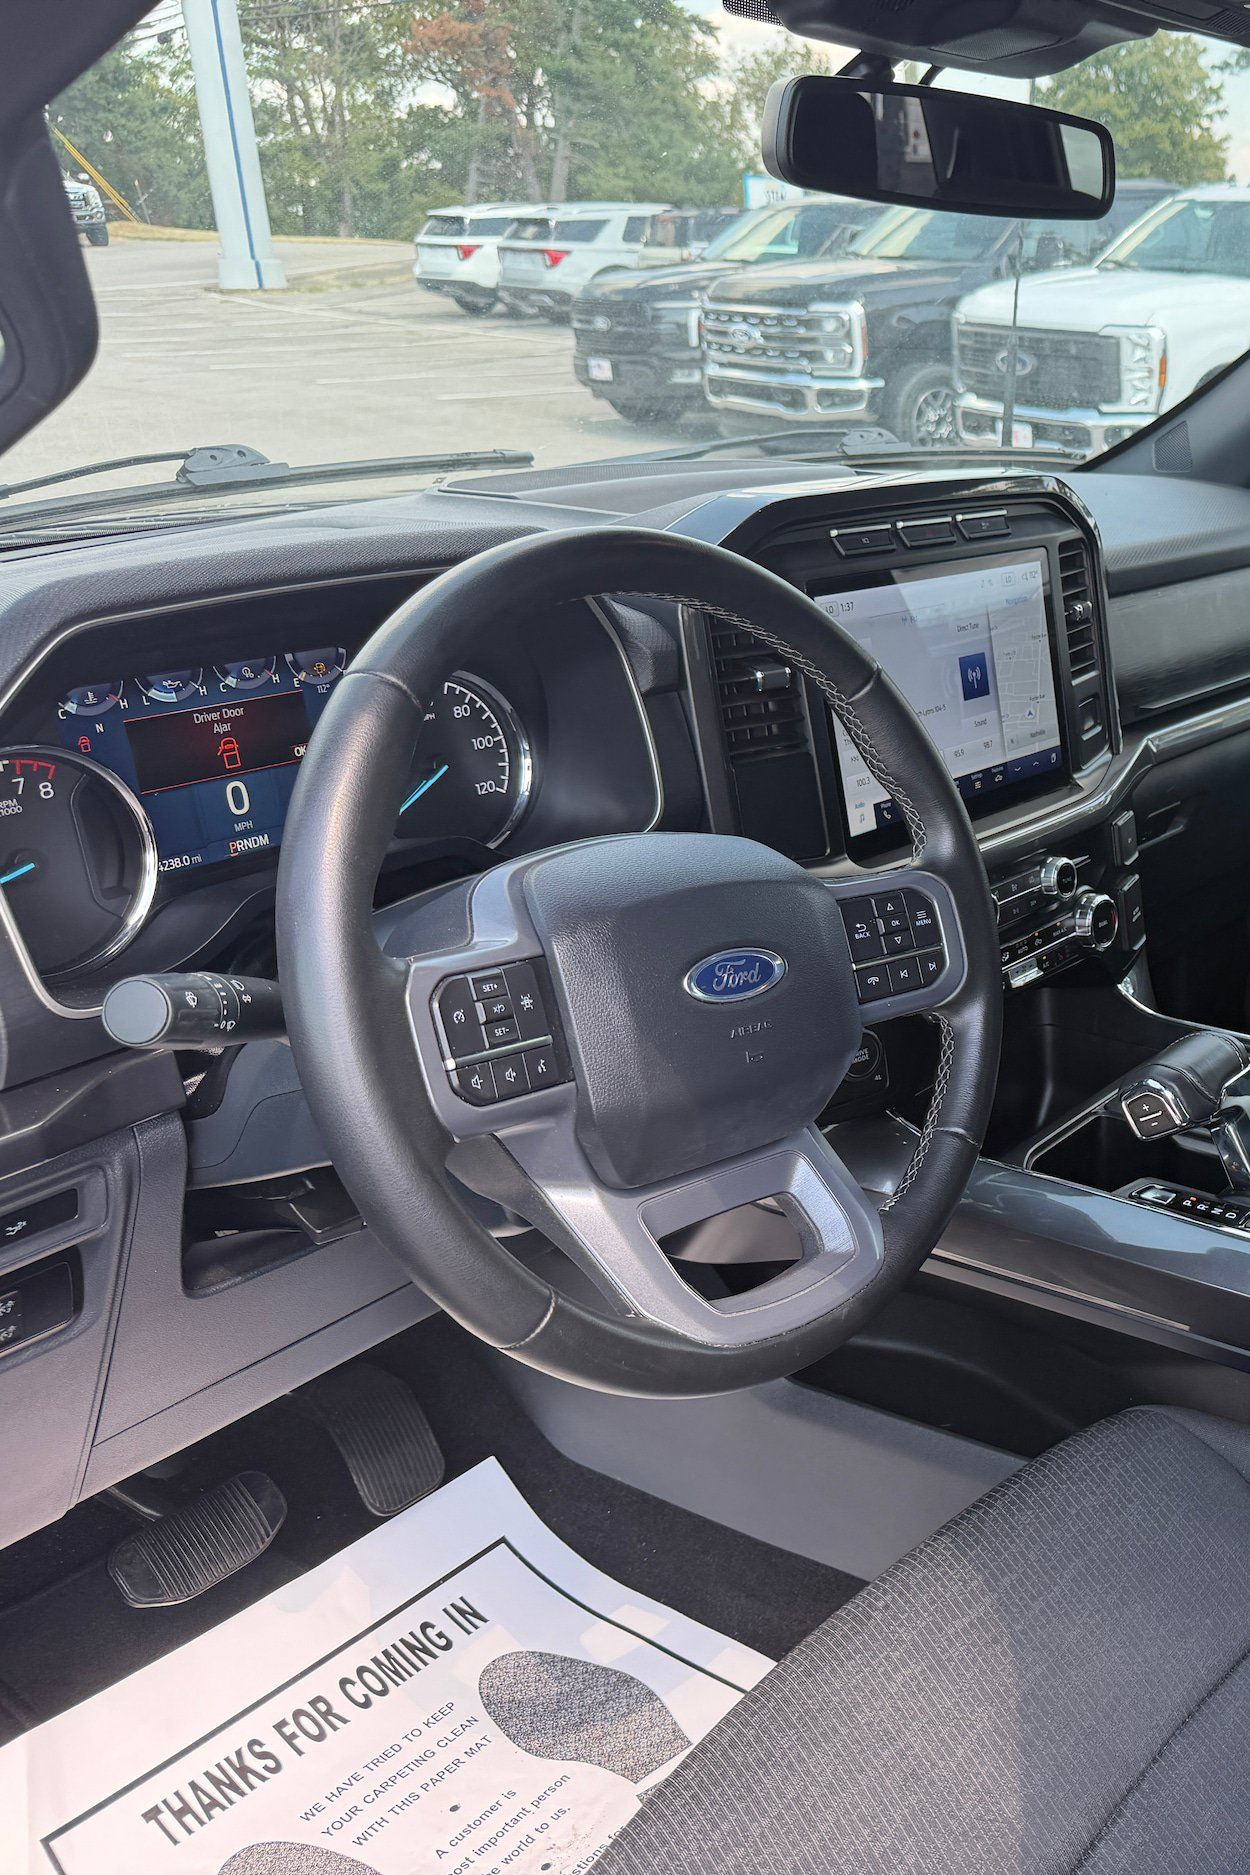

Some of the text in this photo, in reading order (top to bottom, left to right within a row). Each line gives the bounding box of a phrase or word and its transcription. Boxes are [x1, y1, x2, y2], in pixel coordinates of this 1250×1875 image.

[272, 673, 281, 684] H
[293, 678, 300, 688] E
[199, 686, 208, 696] H
[219, 683, 227, 693] C
[119, 699, 129, 709] H
[142, 695, 150, 706] L
[58, 708, 67, 720] C
[193, 706, 245, 724] Driver Door
[453, 704, 471, 719] 80
[95, 723, 105, 733] N
[213, 721, 232, 735] Ajar
[471, 735, 494, 750] 100
[11, 777, 25, 795] 7
[39, 782, 55, 799] 8
[475, 780, 496, 795] 120
[226, 780, 250, 816] 0
[0, 805, 23, 817] 1000
[234, 820, 254, 833] MPH
[891, 919, 901, 927] OK
[915, 918, 932, 927] MENU
[854, 931, 871, 940] BACK
[712, 957, 763, 992] Ford
[482, 983, 498, 993] SET+
[494, 1027, 510, 1037] SET-
[141, 1596, 490, 1847] THANKS FOR COMING IN
[299, 1702, 456, 1822] WE HAVE TRIED TO KEEP
[321, 1715, 480, 1838] YOUR CARPETING CLEAN
[352, 1734, 493, 1847] WITH THIS PAPER MAT
[474, 1808, 532, 1857] important
[531, 1774, 571, 1809] person
[435, 1788, 517, 1860] A customer is
[501, 1834, 536, 1866] world
[534, 1822, 550, 1834] to
[550, 1808, 571, 1822] us.
